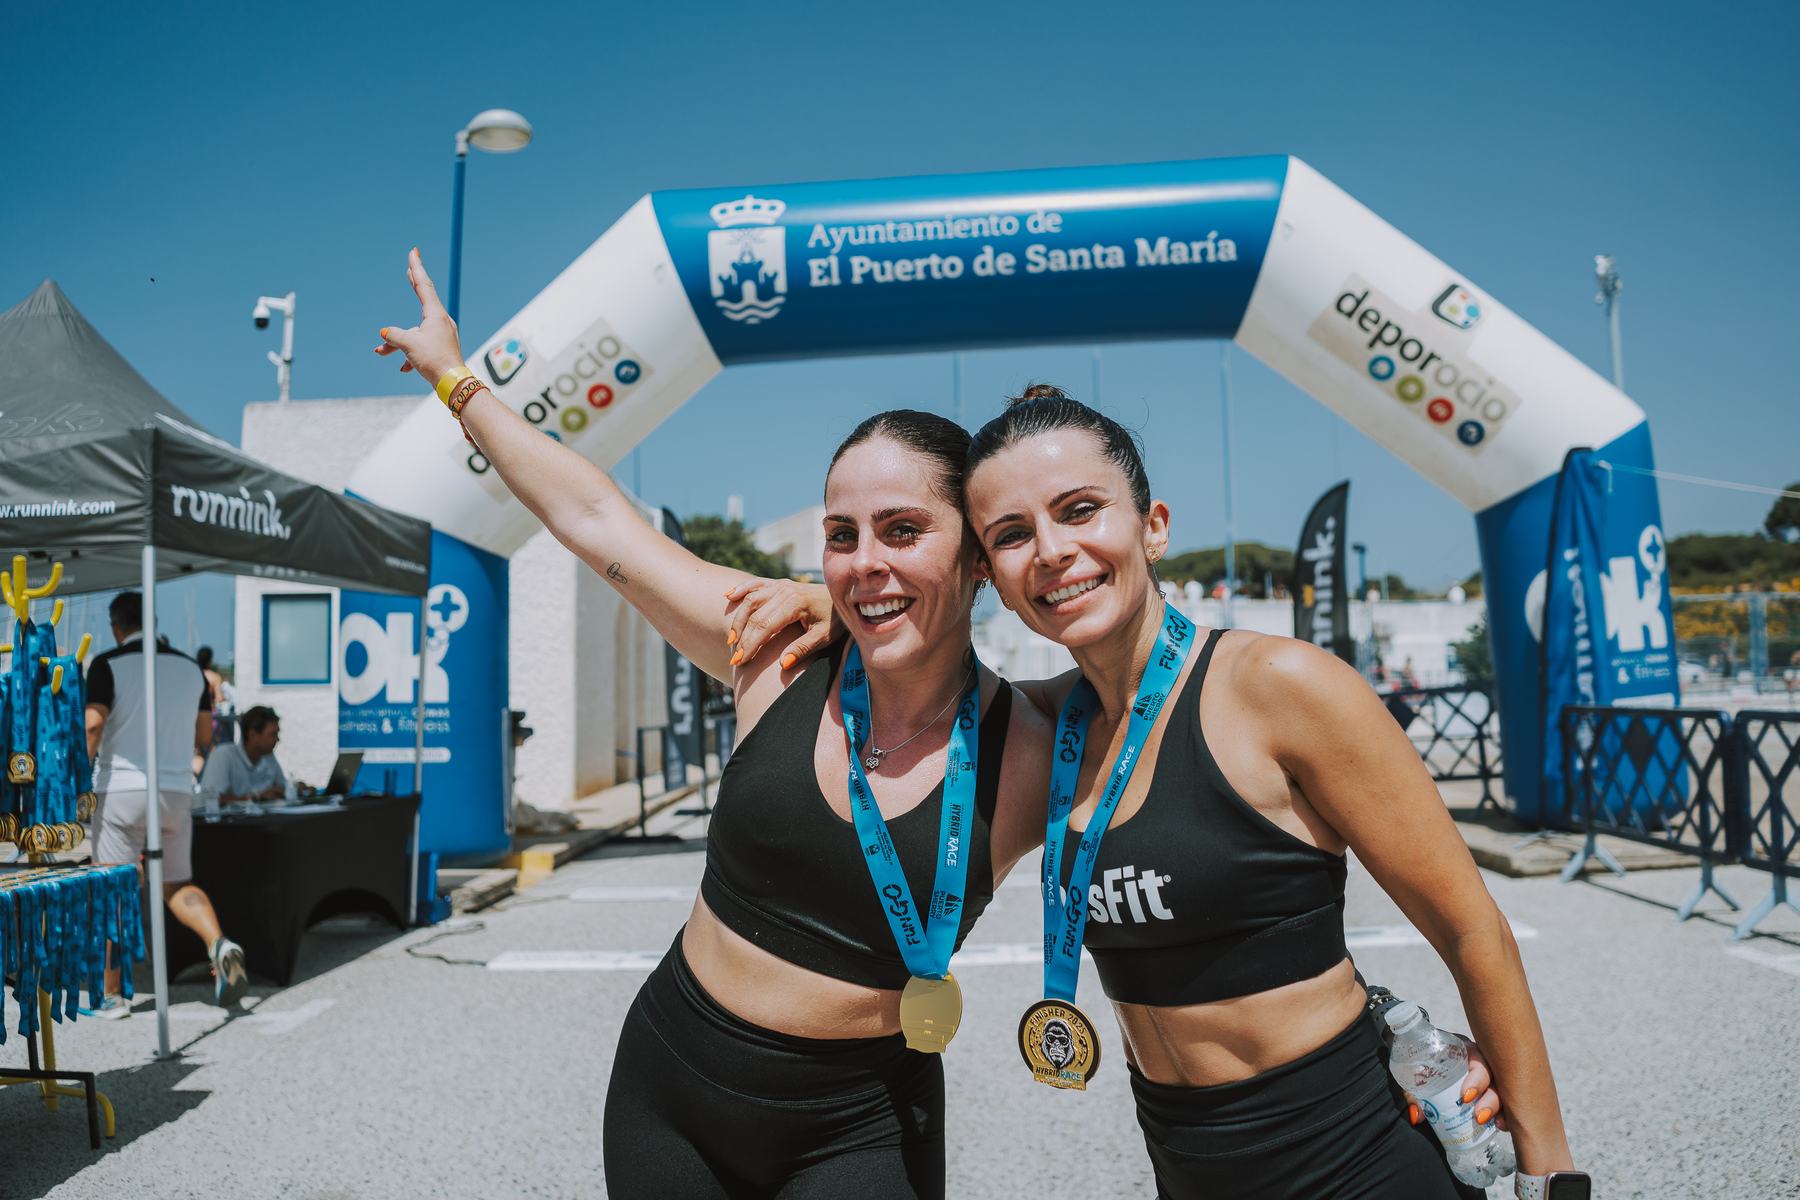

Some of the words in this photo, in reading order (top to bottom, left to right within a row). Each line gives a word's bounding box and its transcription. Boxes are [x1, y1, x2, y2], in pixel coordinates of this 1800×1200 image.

[807, 213, 1019, 254] Ayuntamiento
[1027, 209, 1062, 235] de
[808, 254, 842, 287] El
[851, 248, 966, 284] Puerto
[973, 244, 1016, 277] de
[1025, 241, 1126, 273] Santa
[1135, 230, 1238, 266] María
[1335, 289, 1507, 423] deporocio
